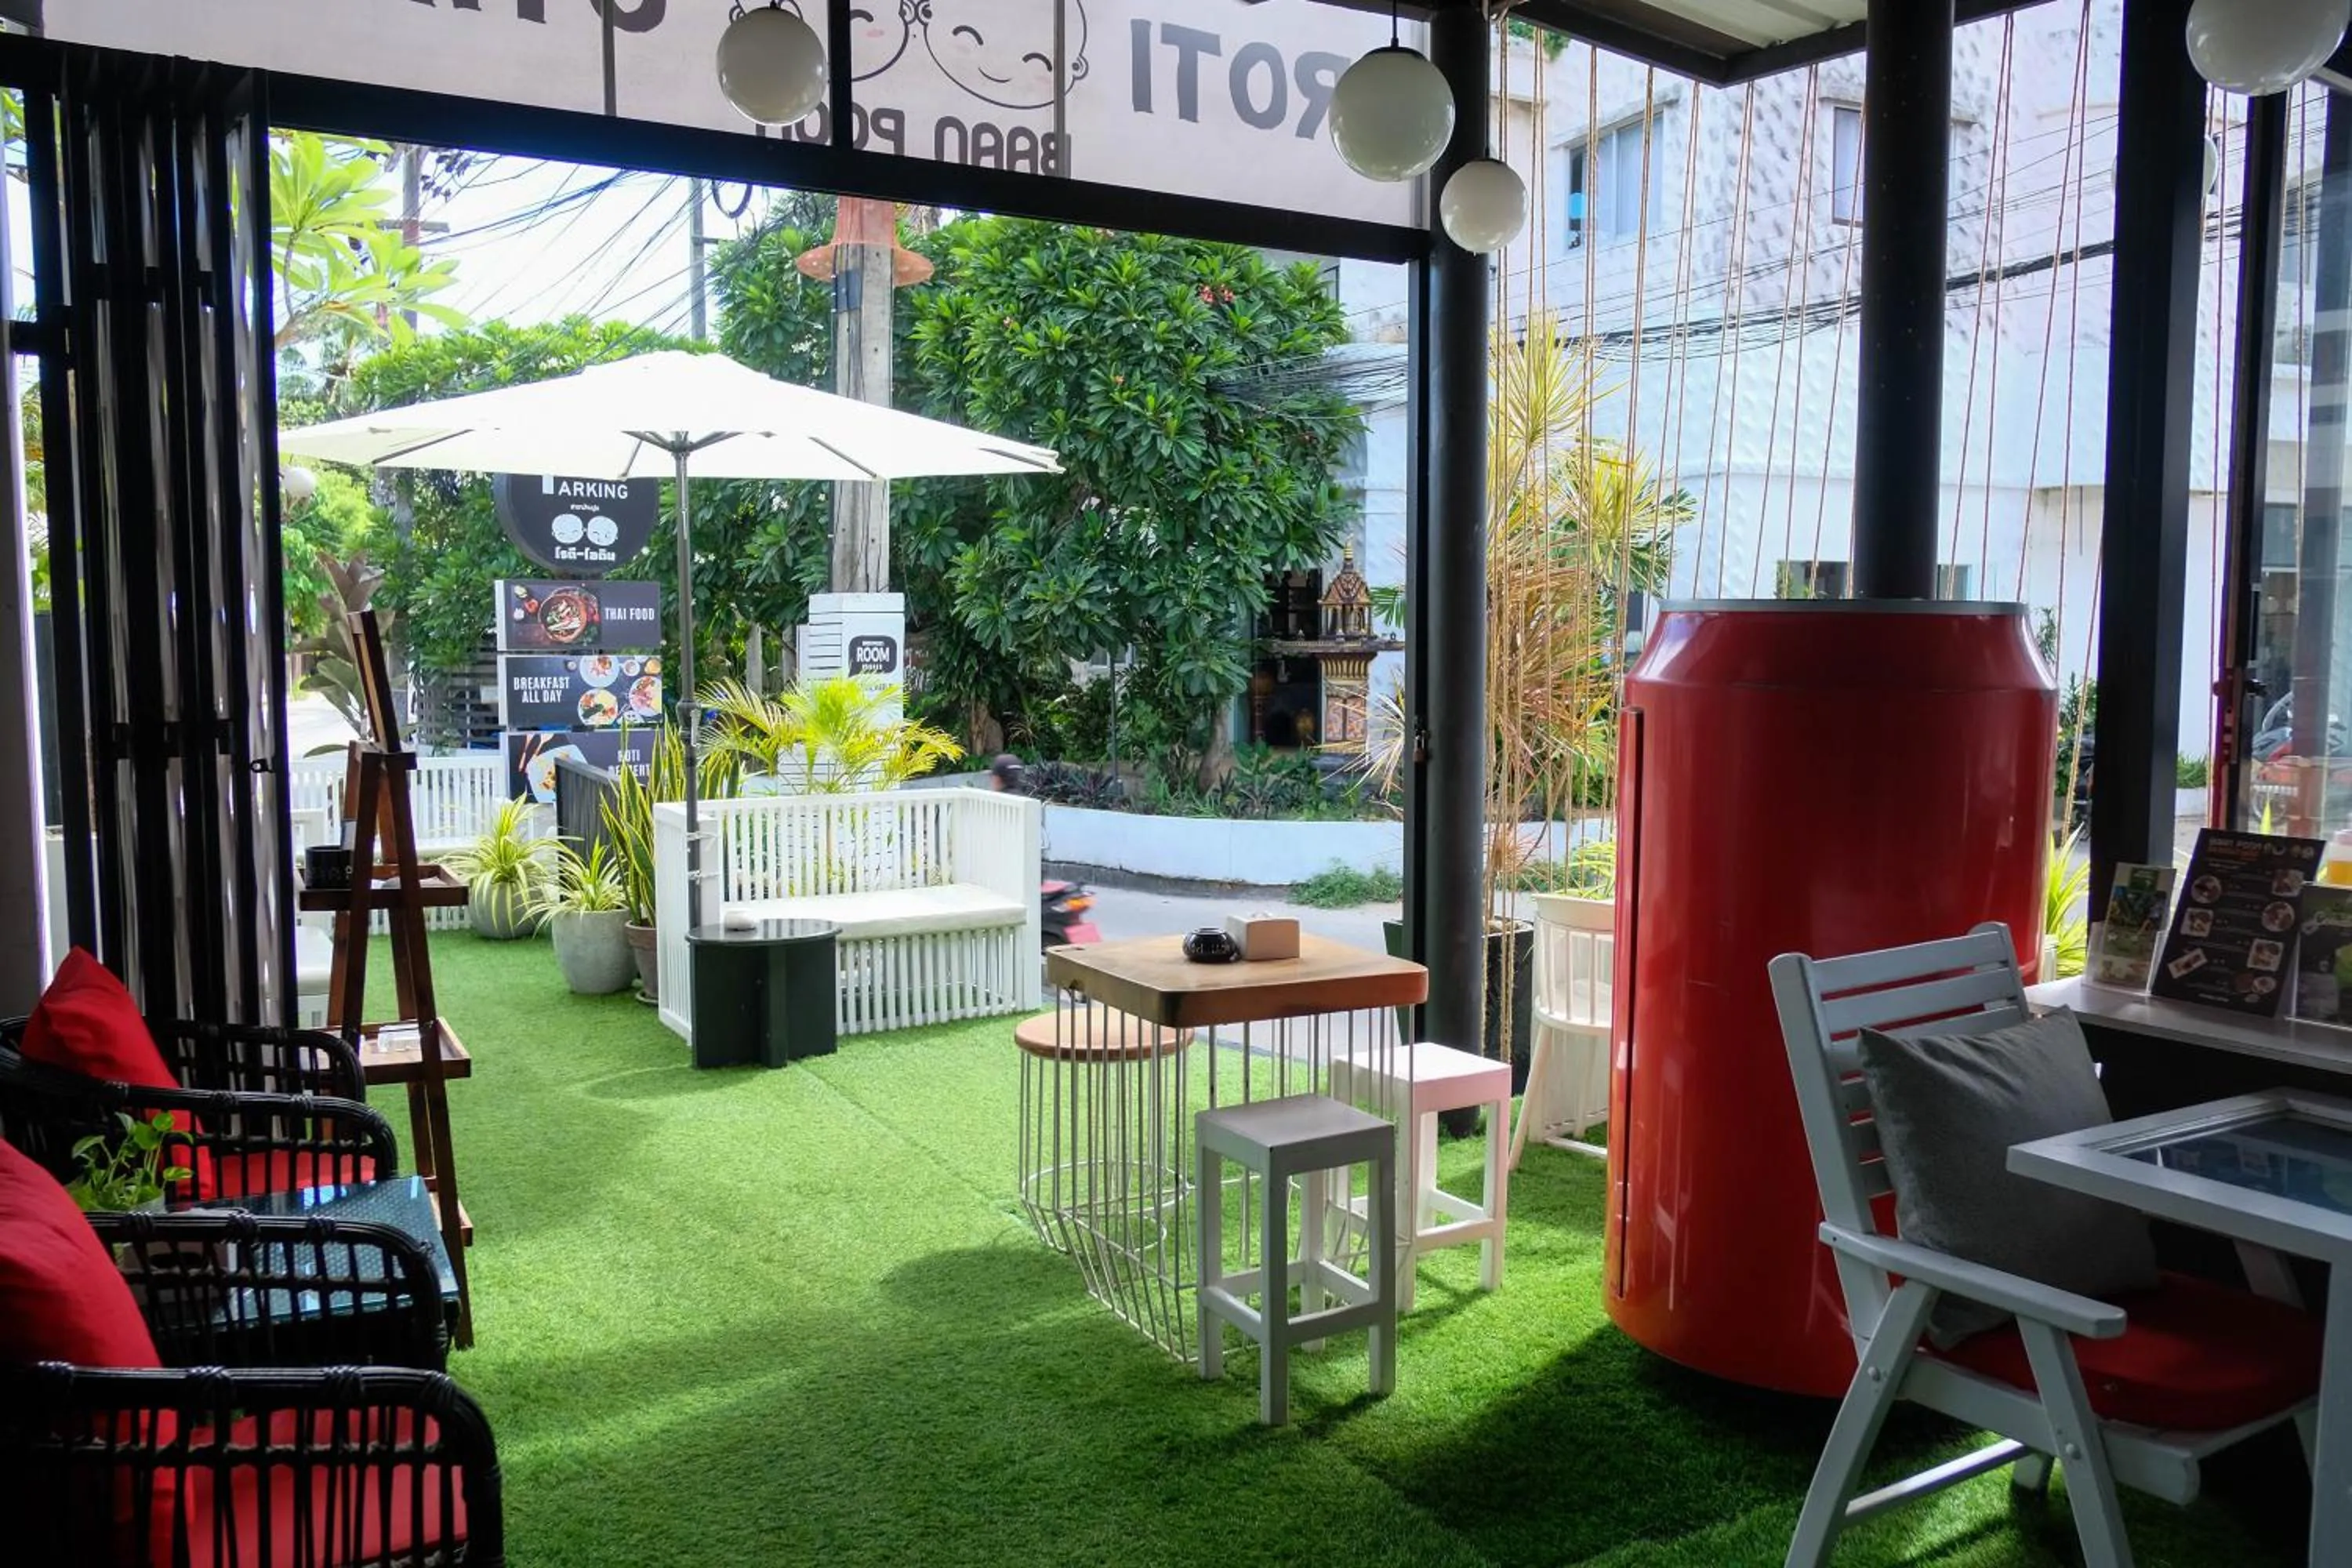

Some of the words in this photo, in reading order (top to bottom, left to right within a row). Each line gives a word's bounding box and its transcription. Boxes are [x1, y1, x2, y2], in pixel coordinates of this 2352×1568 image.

[604, 607, 626, 621] THAI
[630, 608, 655, 621] FOOD
[856, 647, 890, 662] ROOM
[514, 677, 570, 690] BREAKFAST
[521, 690, 539, 703] ALL
[543, 690, 562, 703] DAY
